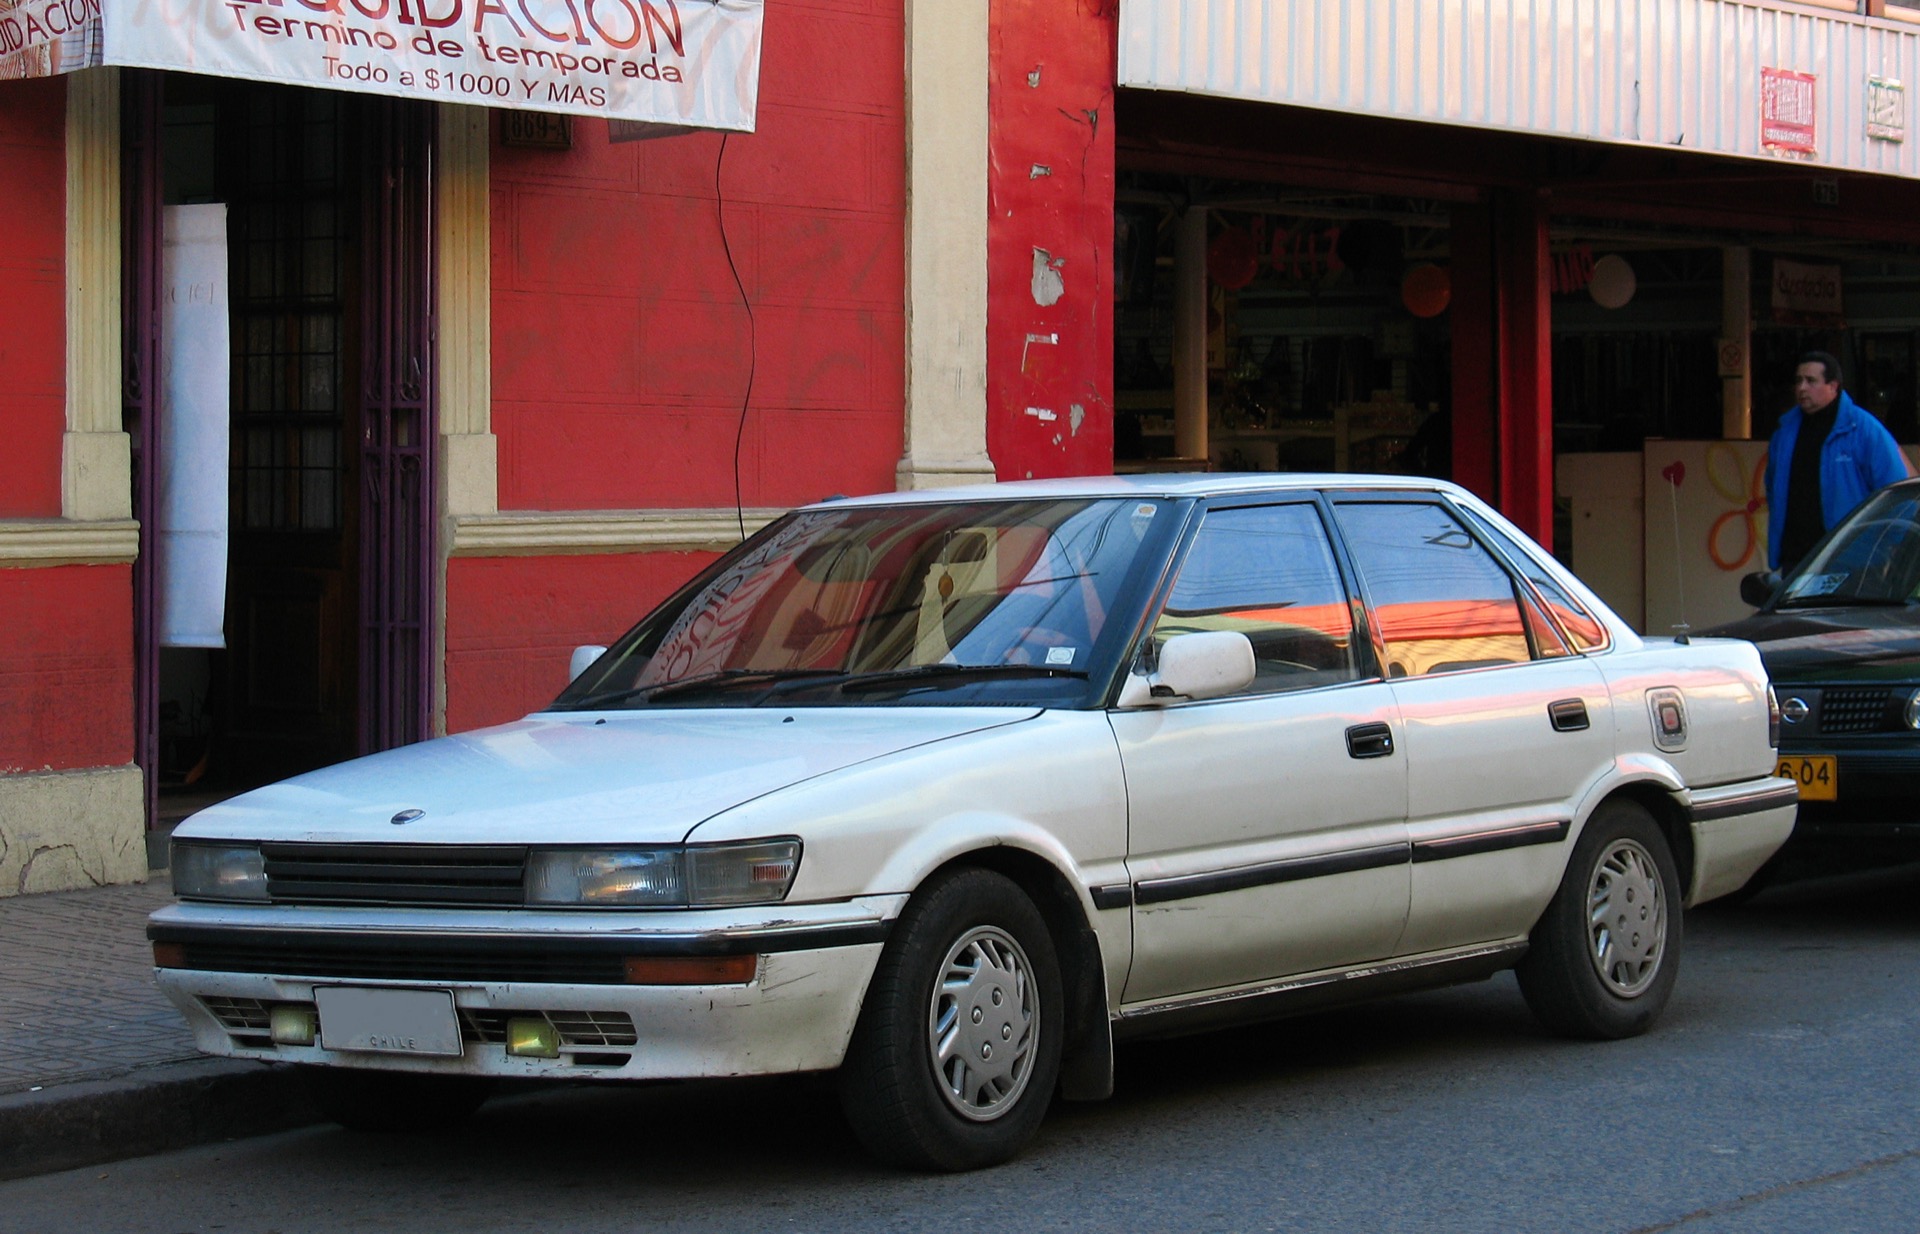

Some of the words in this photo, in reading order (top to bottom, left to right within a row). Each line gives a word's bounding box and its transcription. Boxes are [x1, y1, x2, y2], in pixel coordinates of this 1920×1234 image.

[224, 3, 398, 50] Termino
[411, 30, 464, 58] de
[477, 35, 684, 84] temporada
[322, 56, 389, 83] Todo
[399, 71, 415, 87] a
[424, 68, 510, 97] $1000
[520, 79, 540, 99] Y
[549, 82, 606, 107] MAS
[369, 1034, 417, 1049] CHILE
